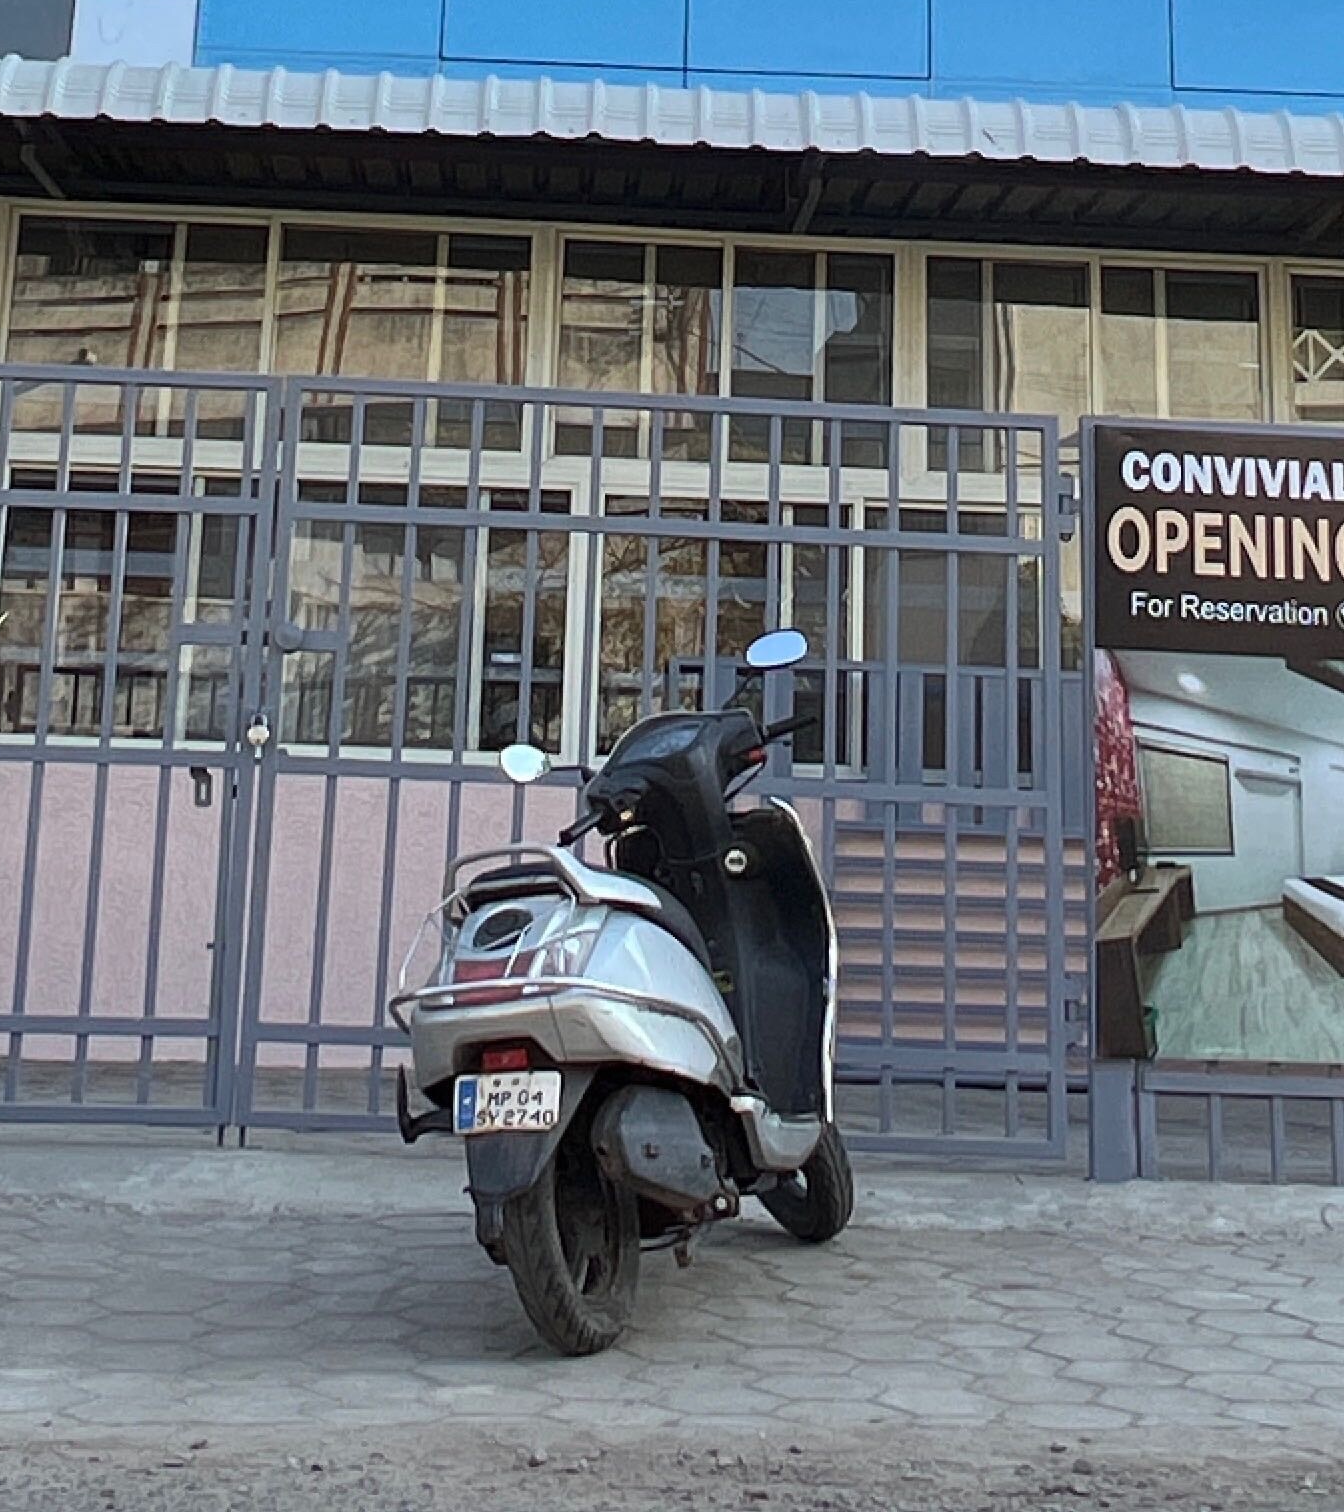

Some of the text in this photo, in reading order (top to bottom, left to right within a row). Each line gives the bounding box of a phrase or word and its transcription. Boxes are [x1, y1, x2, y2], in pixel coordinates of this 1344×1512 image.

[1130, 591, 1172, 619] For
[1180, 593, 1329, 627] Reservation
[487, 1089, 544, 1107] MP 04
[502, 1108, 555, 1126] 2740
